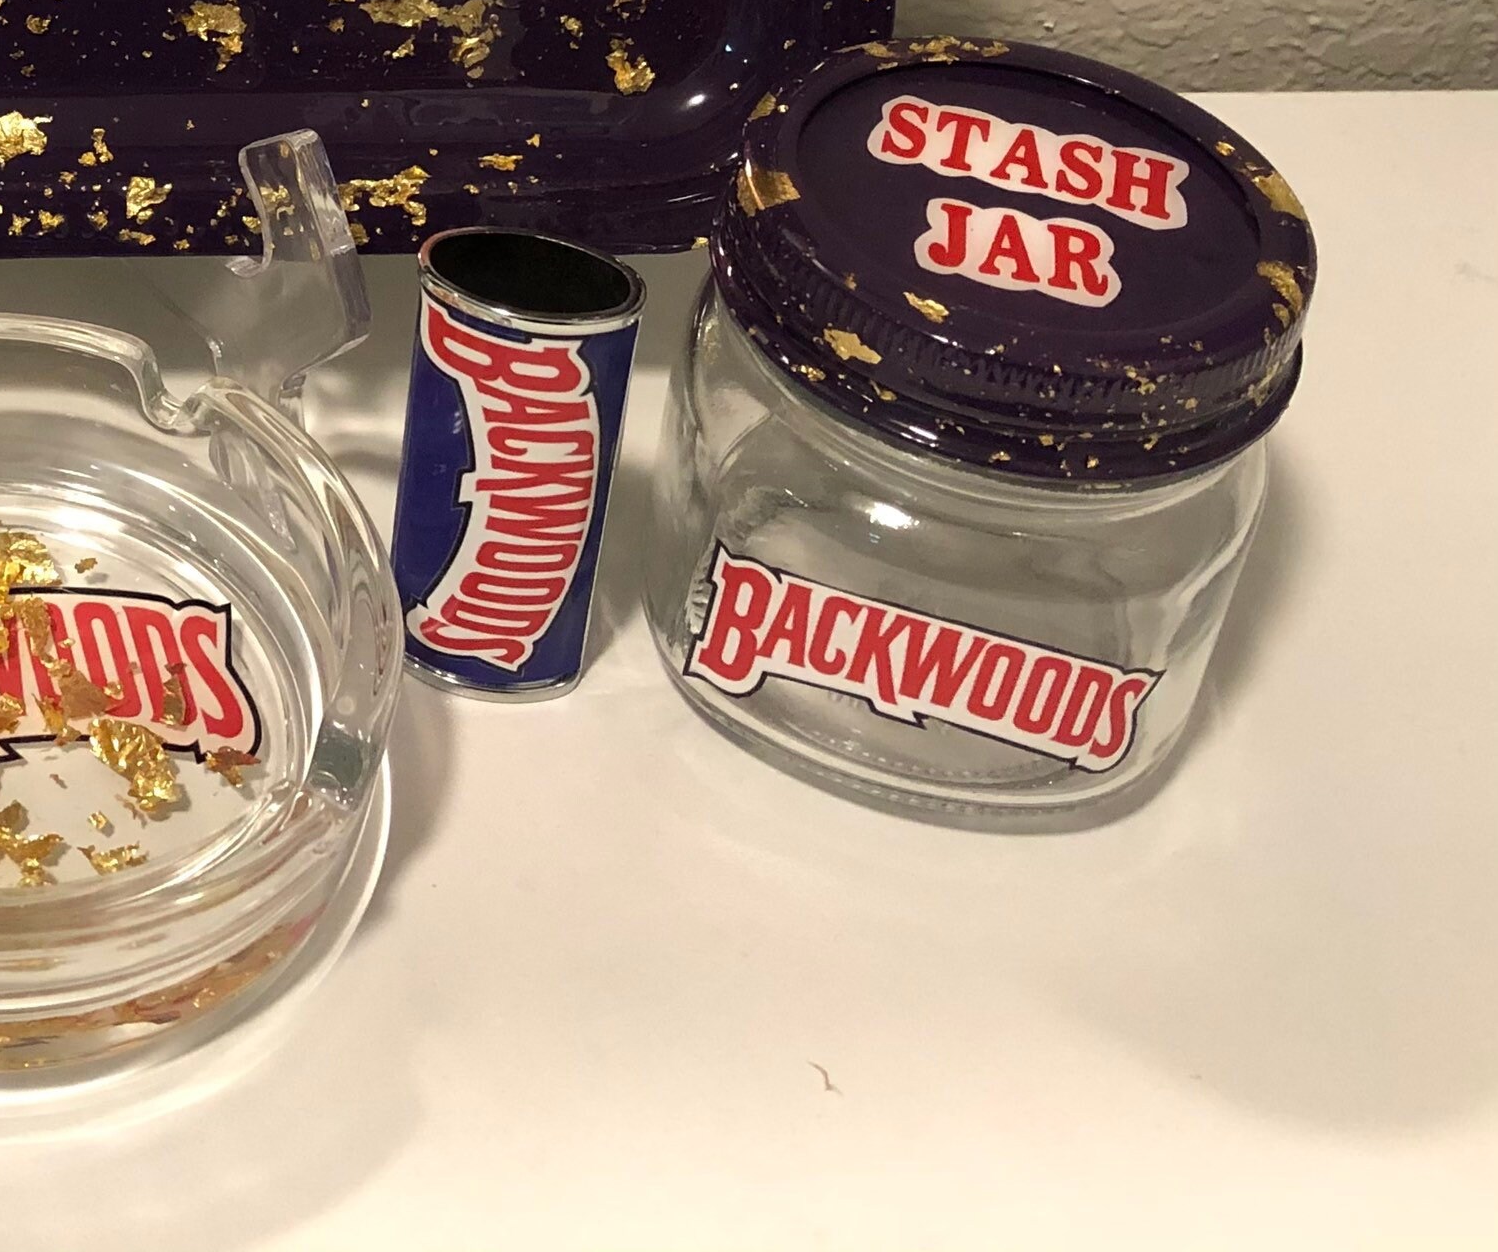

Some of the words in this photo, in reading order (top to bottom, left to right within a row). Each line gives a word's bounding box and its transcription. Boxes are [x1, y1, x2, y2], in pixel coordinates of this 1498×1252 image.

[880, 101, 1176, 221] STASH
[926, 202, 1111, 297] JAR
[420, 304, 594, 666] BACKWOODS
[698, 560, 1146, 759] BACKWOODS
